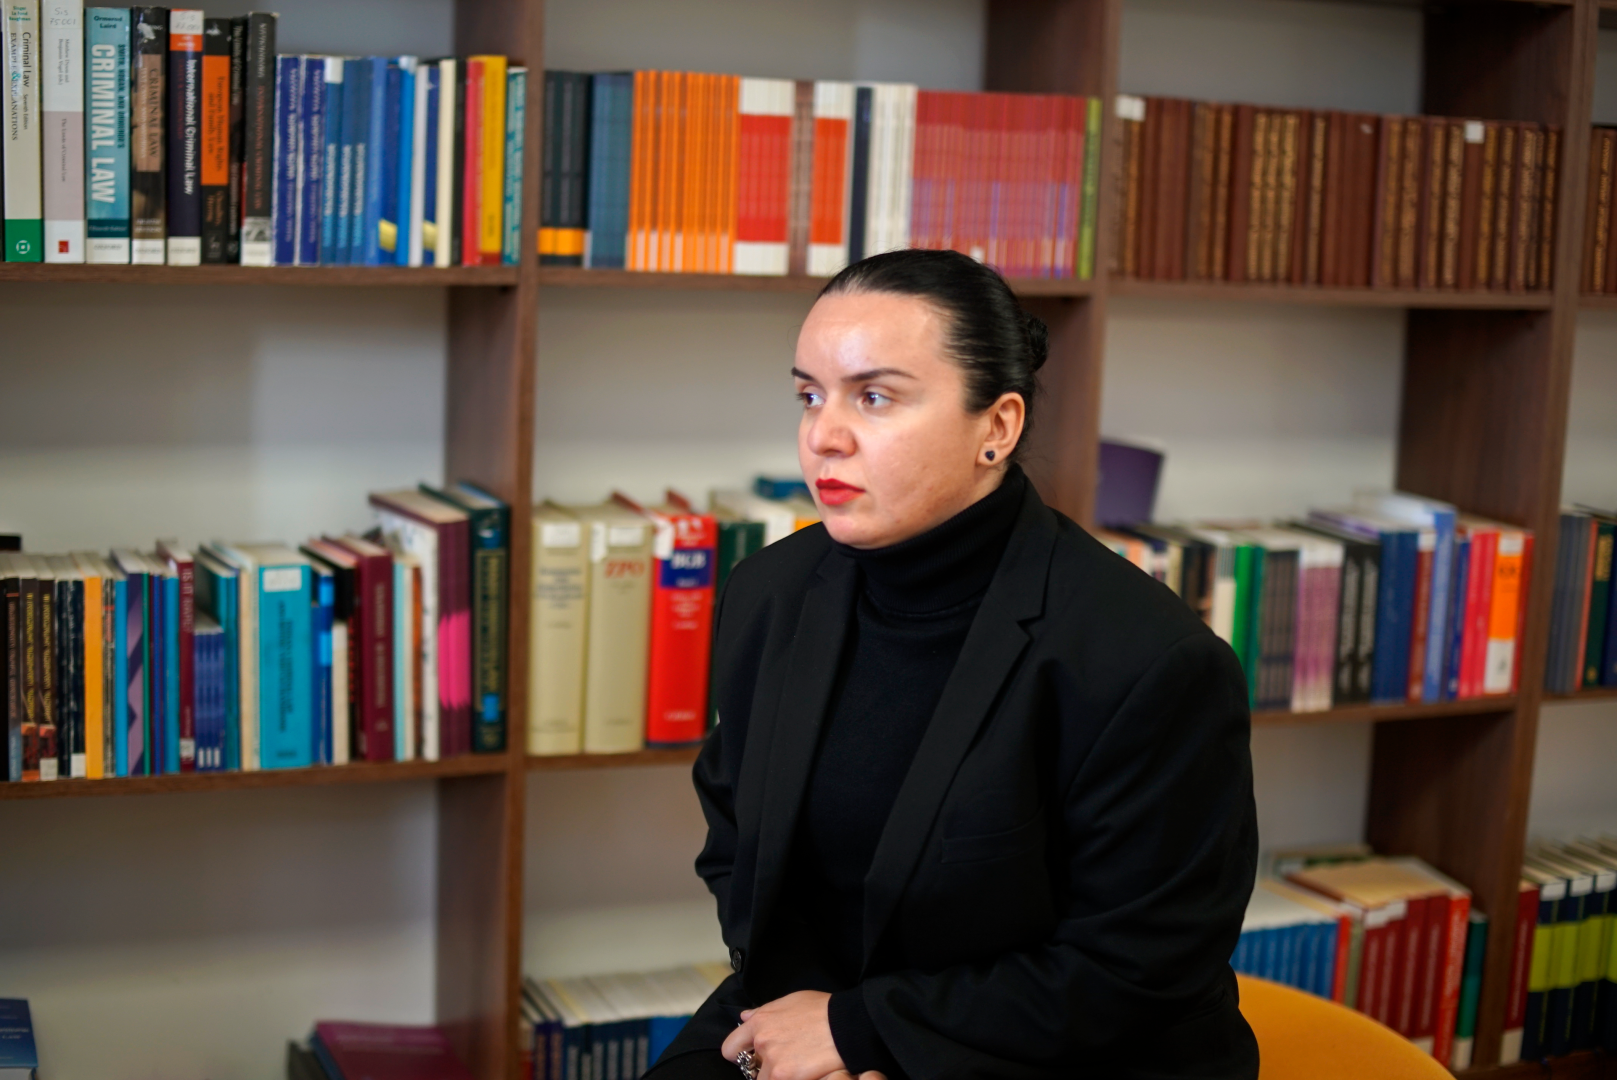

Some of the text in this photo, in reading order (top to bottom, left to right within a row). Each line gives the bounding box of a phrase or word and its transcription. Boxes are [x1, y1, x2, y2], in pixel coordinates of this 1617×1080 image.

[23, 32, 31, 67] Criminal
[23, 71, 31, 87] Law
[185, 59, 197, 125] International
[216, 76, 225, 113] European
[149, 68, 159, 157] CRIMINAL LAW
[208, 92, 216, 108] and
[91, 44, 115, 203] CRIMINAL LAW
[184, 127, 196, 171] Criminal
[184, 172, 196, 196] Law
